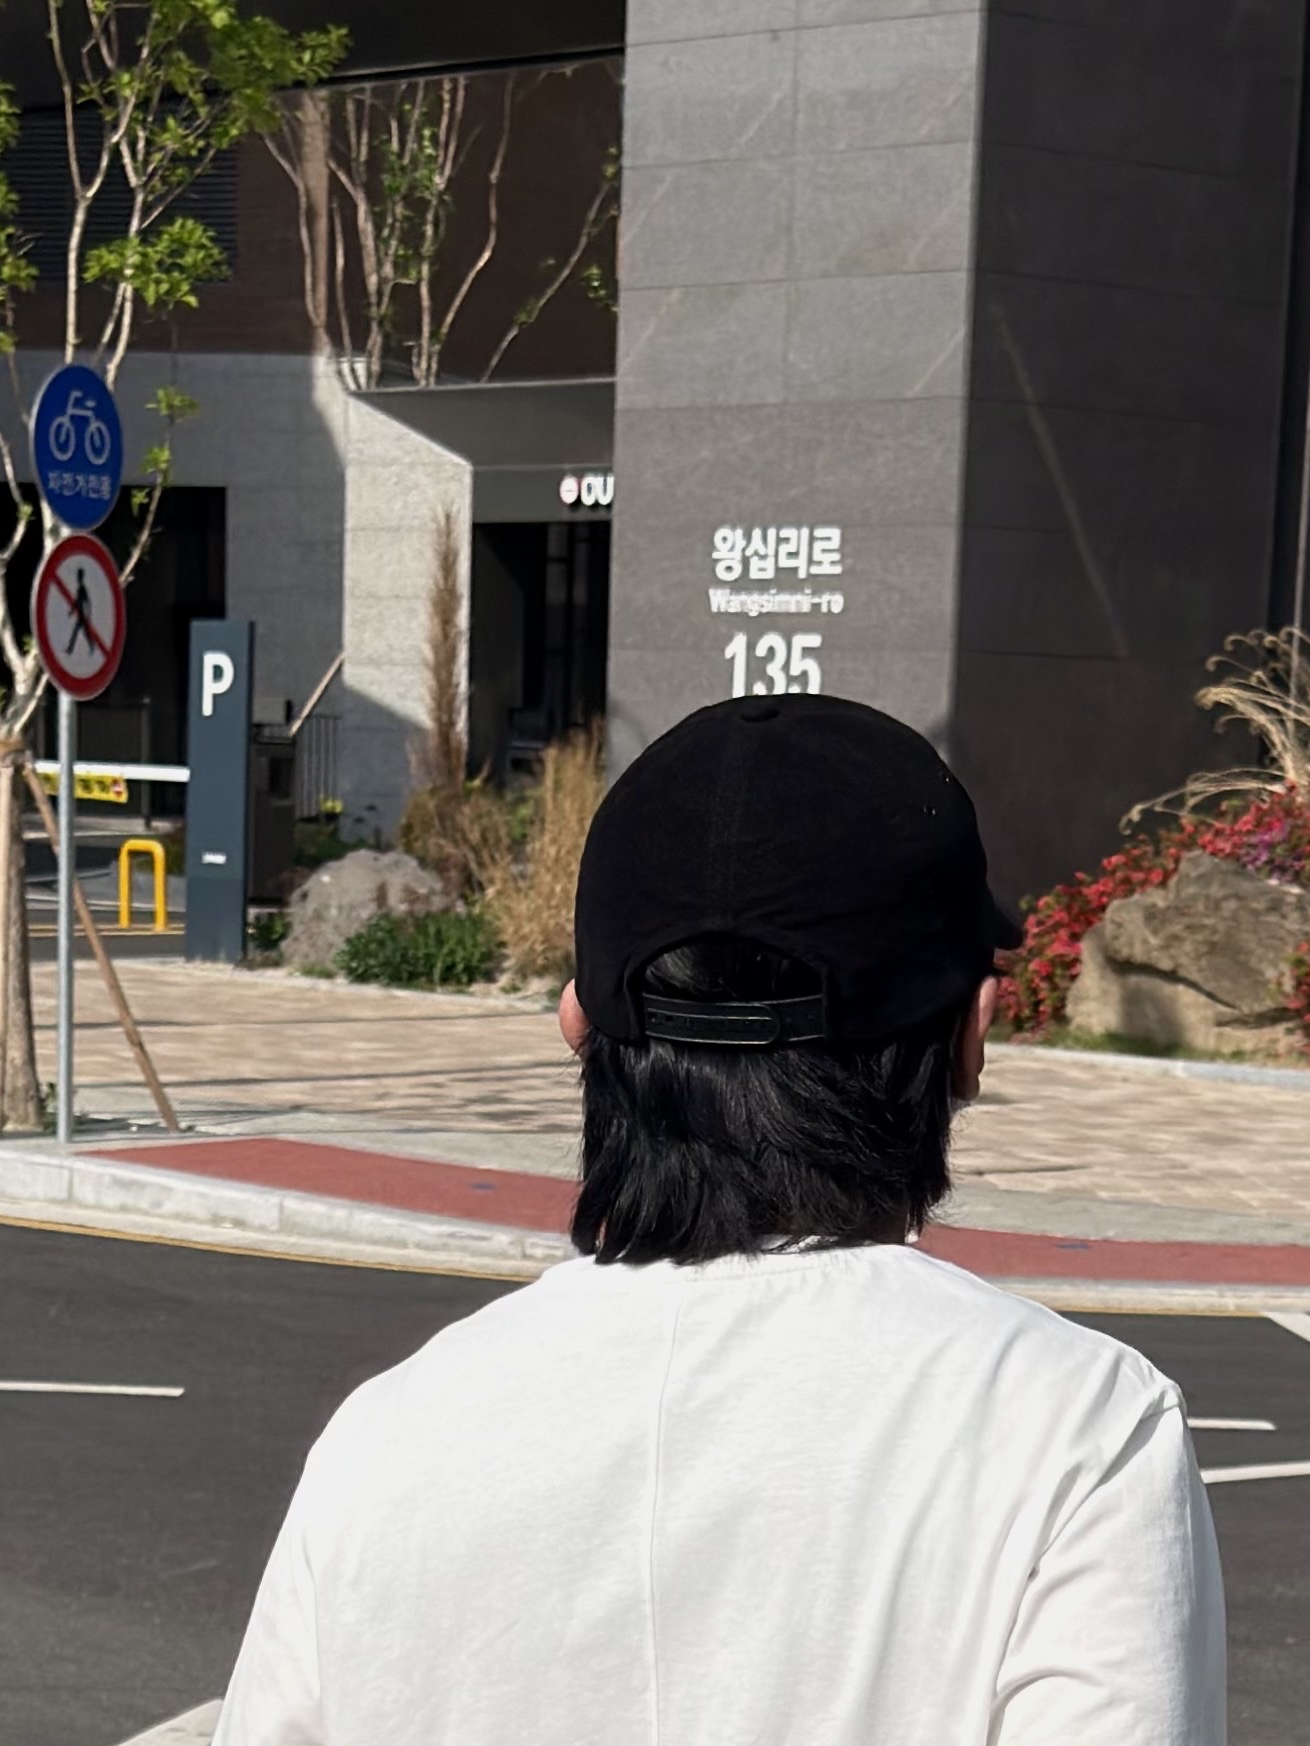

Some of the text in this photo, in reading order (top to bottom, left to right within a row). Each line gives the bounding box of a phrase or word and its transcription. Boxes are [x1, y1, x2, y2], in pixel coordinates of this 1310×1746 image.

[711, 526, 843, 582] 왕십리로
[708, 587, 845, 617] Wangsimni-ro
[201, 650, 234, 717] P
[724, 632, 823, 699] 135
